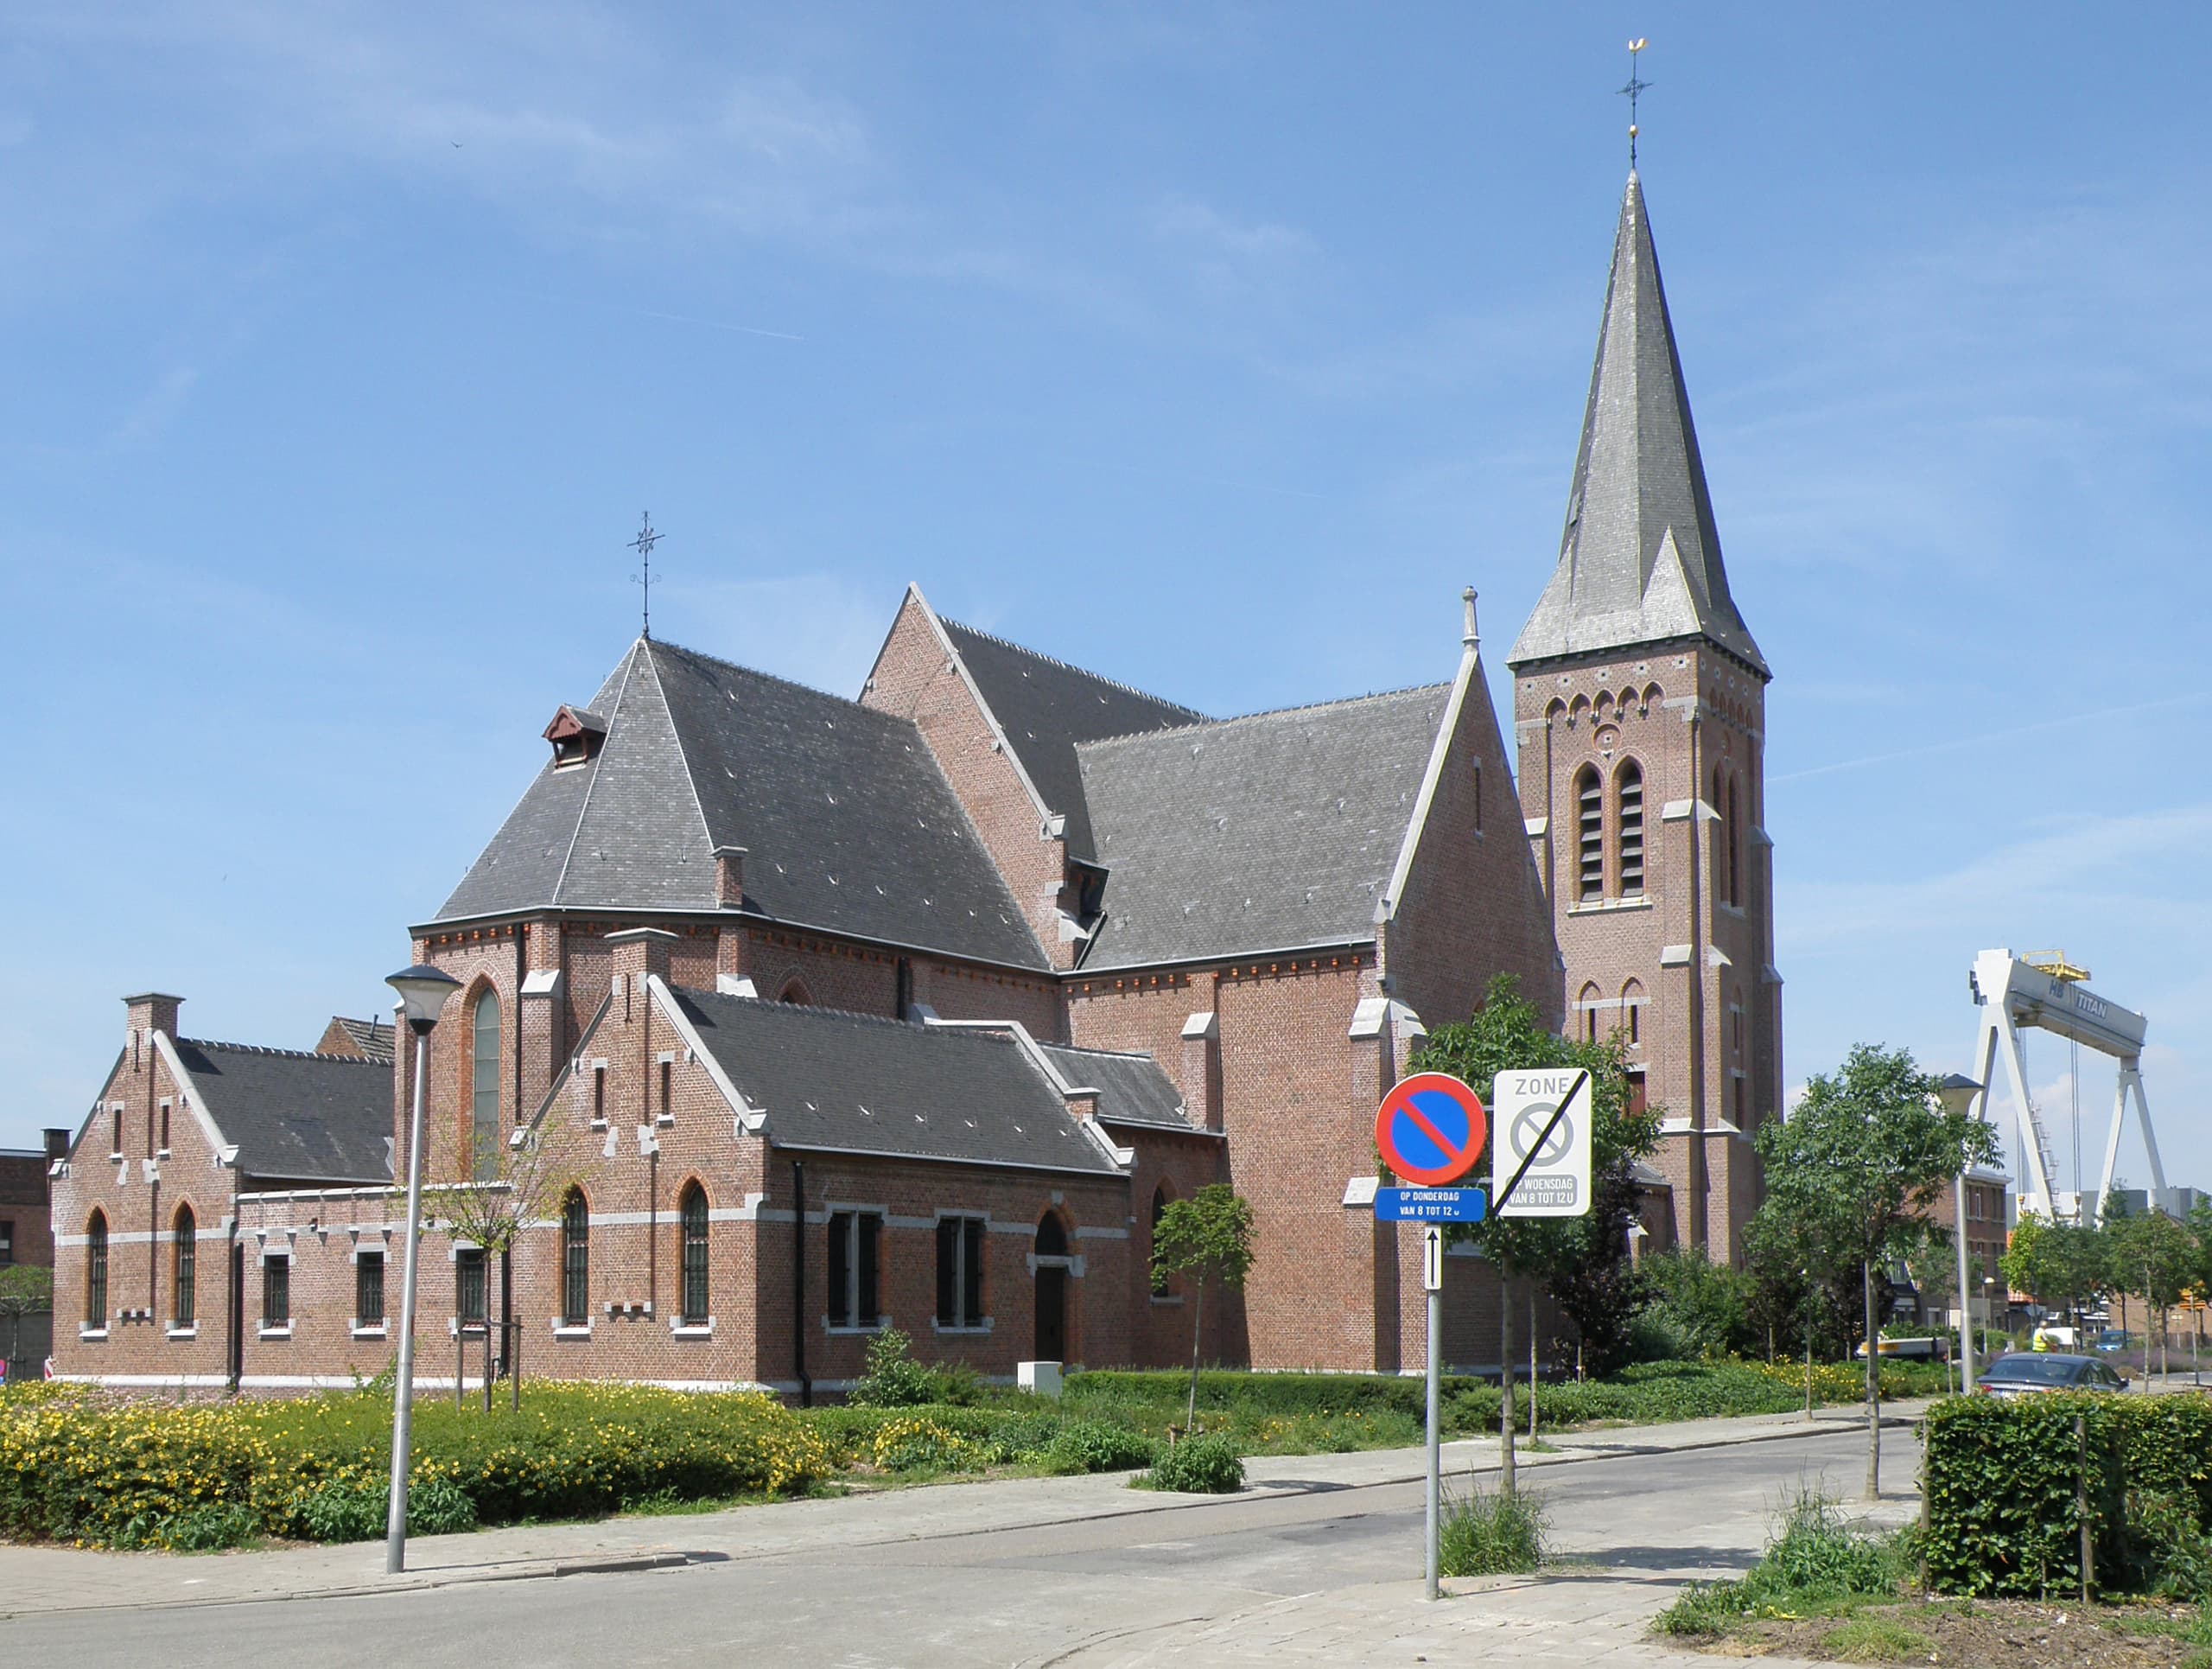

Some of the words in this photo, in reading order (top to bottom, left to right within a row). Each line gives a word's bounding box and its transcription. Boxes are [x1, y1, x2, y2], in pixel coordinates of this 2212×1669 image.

[2077, 992, 2107, 1018] TITAN
[1515, 1077, 1569, 1095] ZONE
[1524, 1178, 1573, 1190] WOENSDAG
[1400, 1191, 1411, 1201] OP
[1413, 1191, 1459, 1201] DONDERDAG
[1510, 1193, 1527, 1204] VAN
[1529, 1193, 1535, 1204] 8
[1538, 1193, 1554, 1204] TOT
[1400, 1206, 1415, 1215] VAN
[1417, 1205, 1424, 1216] 8
[1426, 1206, 1440, 1215] TOT
[1443, 1206, 1452, 1216] 12
